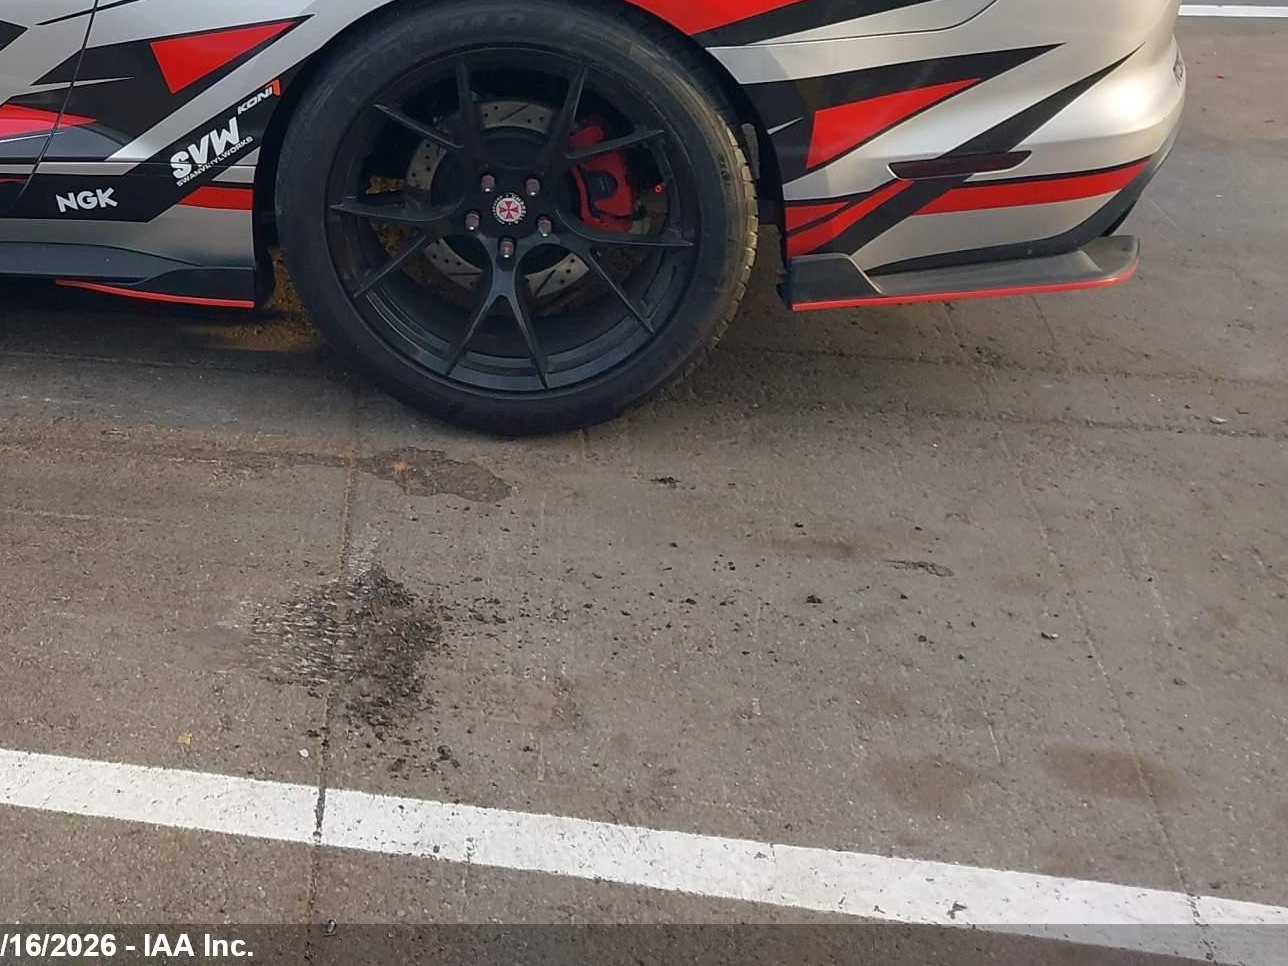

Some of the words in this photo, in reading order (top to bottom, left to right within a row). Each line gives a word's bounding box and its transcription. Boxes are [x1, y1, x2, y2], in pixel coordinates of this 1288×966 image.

[237, 86, 273, 115] KONI
[170, 116, 240, 178] SVW
[56, 187, 118, 212] NGK
